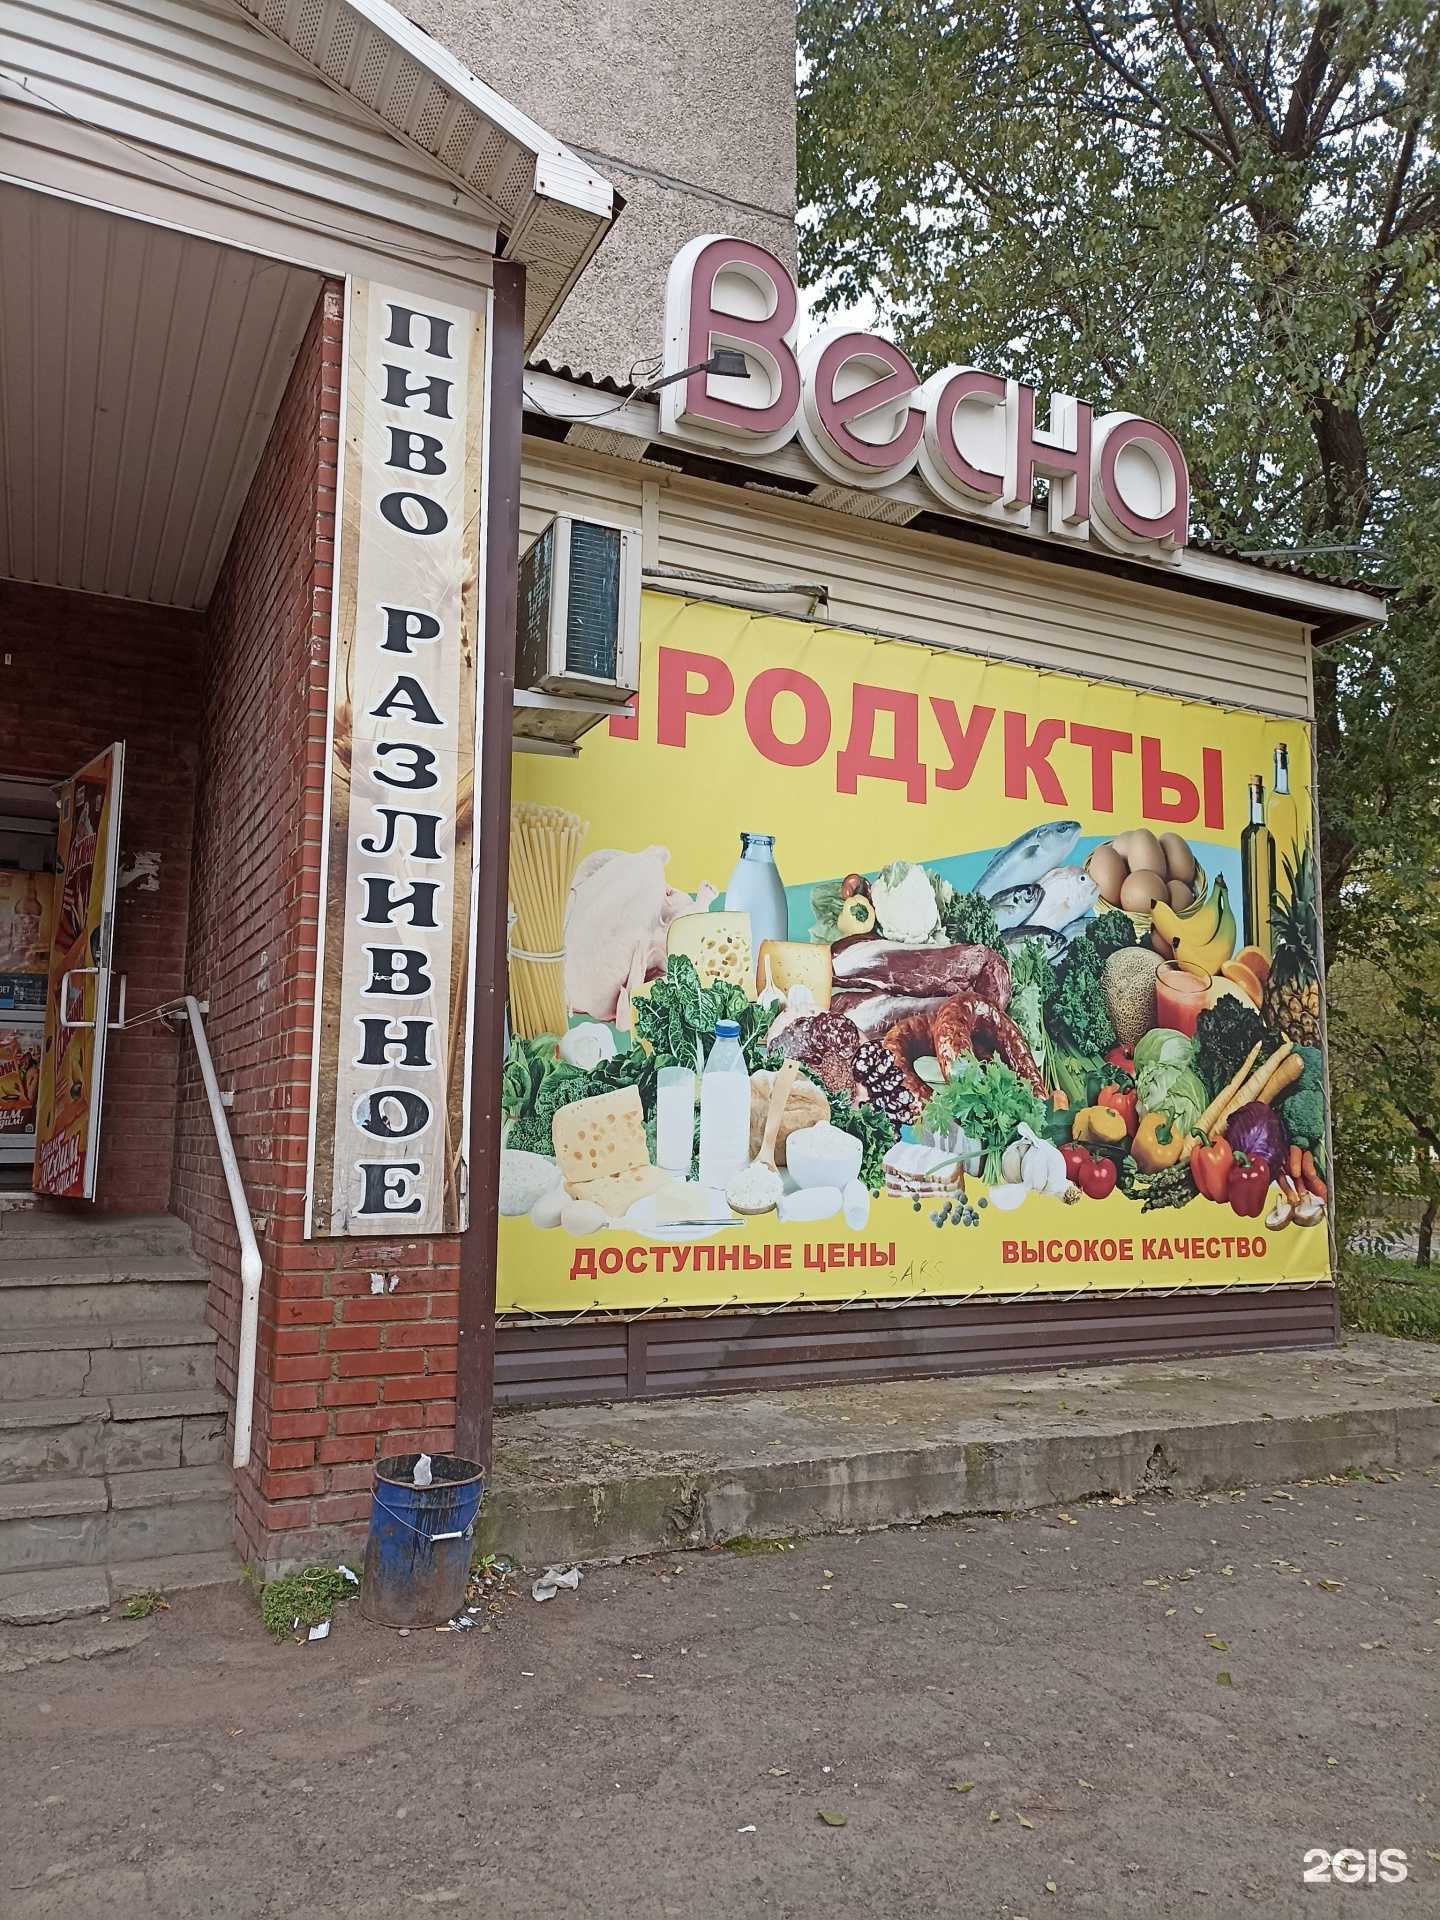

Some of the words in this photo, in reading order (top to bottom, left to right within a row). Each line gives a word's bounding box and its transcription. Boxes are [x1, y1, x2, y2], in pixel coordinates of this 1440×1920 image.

[379, 302, 456, 536] ПИВО
[659, 233, 1190, 565] Весна
[608, 645, 1225, 830] РОДУКТЫ
[355, 605, 445, 1215] РАЗЛИВНОЕ
[569, 1244, 792, 1281] ДОСТУПНЫЕ
[803, 1242, 896, 1273] ЦЕНЫ
[1002, 1237, 1133, 1264] ВЫСОКОЕ
[1142, 1235, 1268, 1261] КАЧЕСТВО
